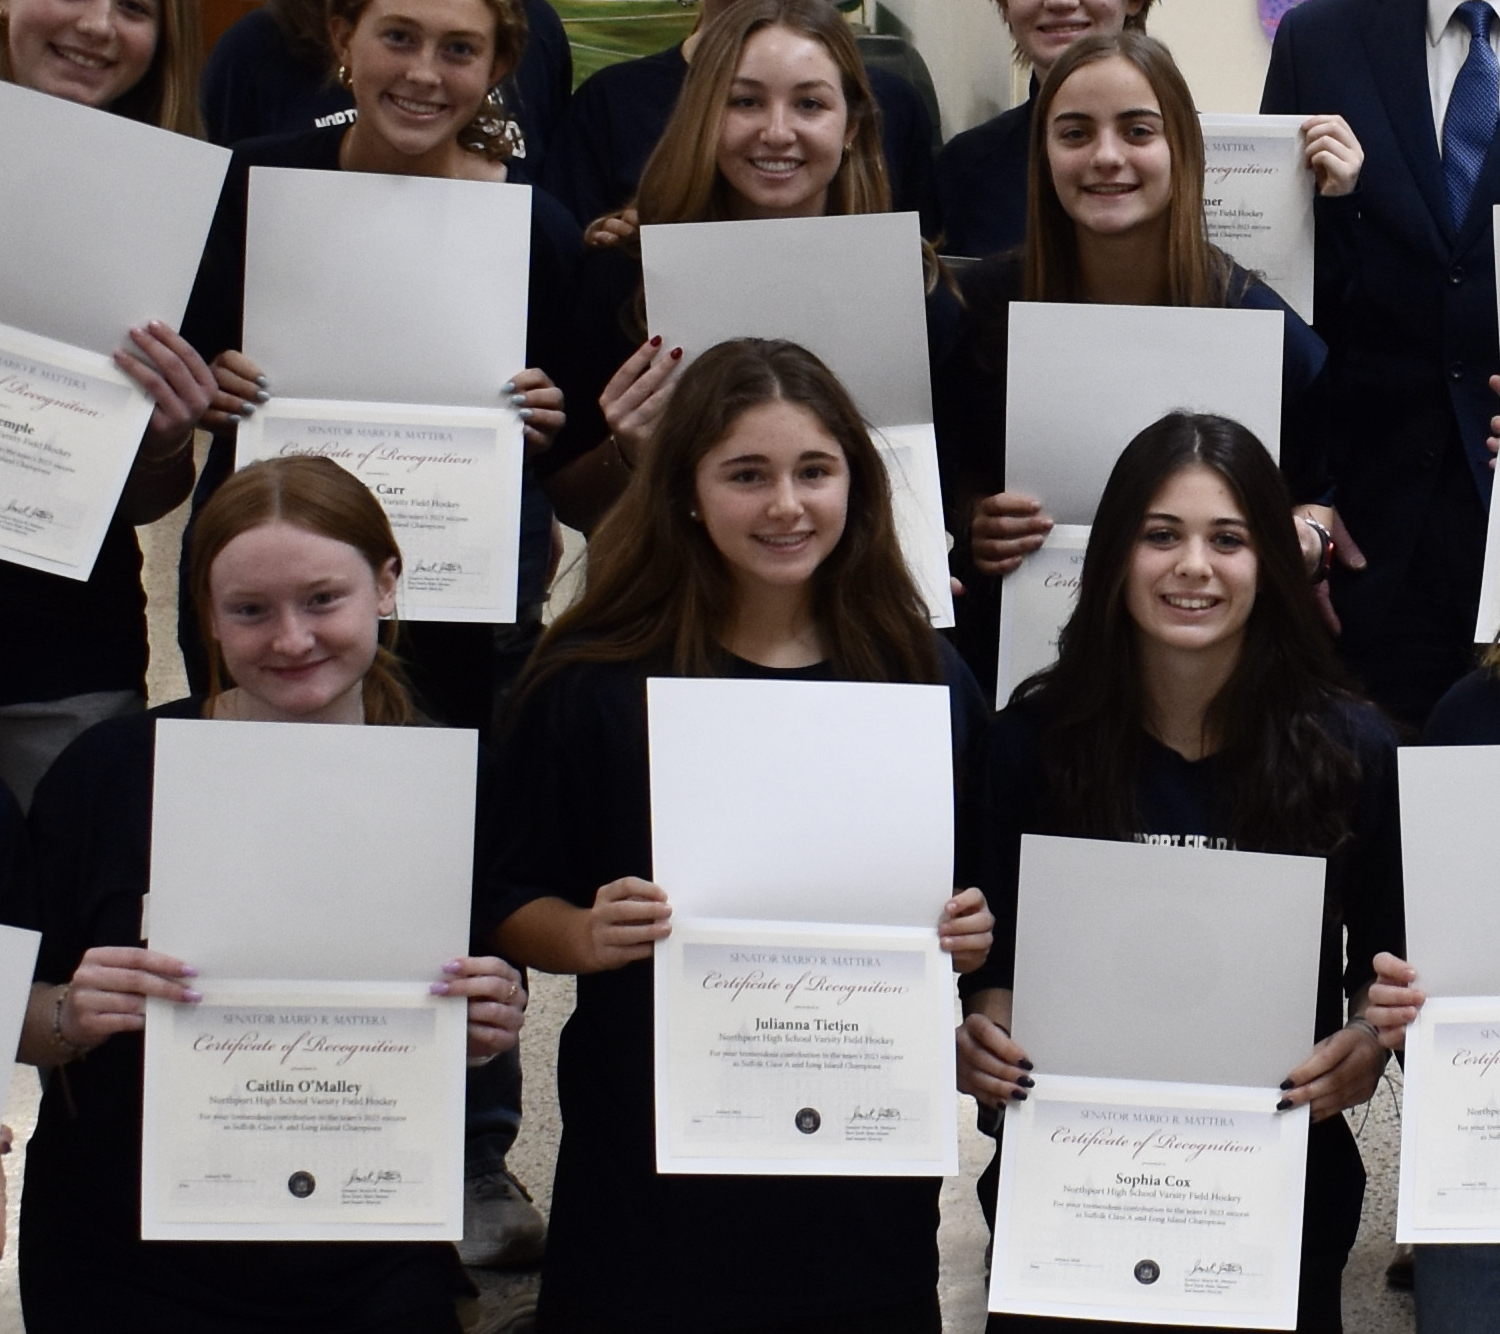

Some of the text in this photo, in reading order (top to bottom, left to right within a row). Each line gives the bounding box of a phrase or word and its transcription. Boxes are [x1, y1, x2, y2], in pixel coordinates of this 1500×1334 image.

[377, 483, 405, 495] Carr
[755, 1018, 859, 1034] Julianna Tietjen
[246, 1080, 362, 1096] Caitlin O'Malley
[1115, 1172, 1191, 1189] Sophia Cox
